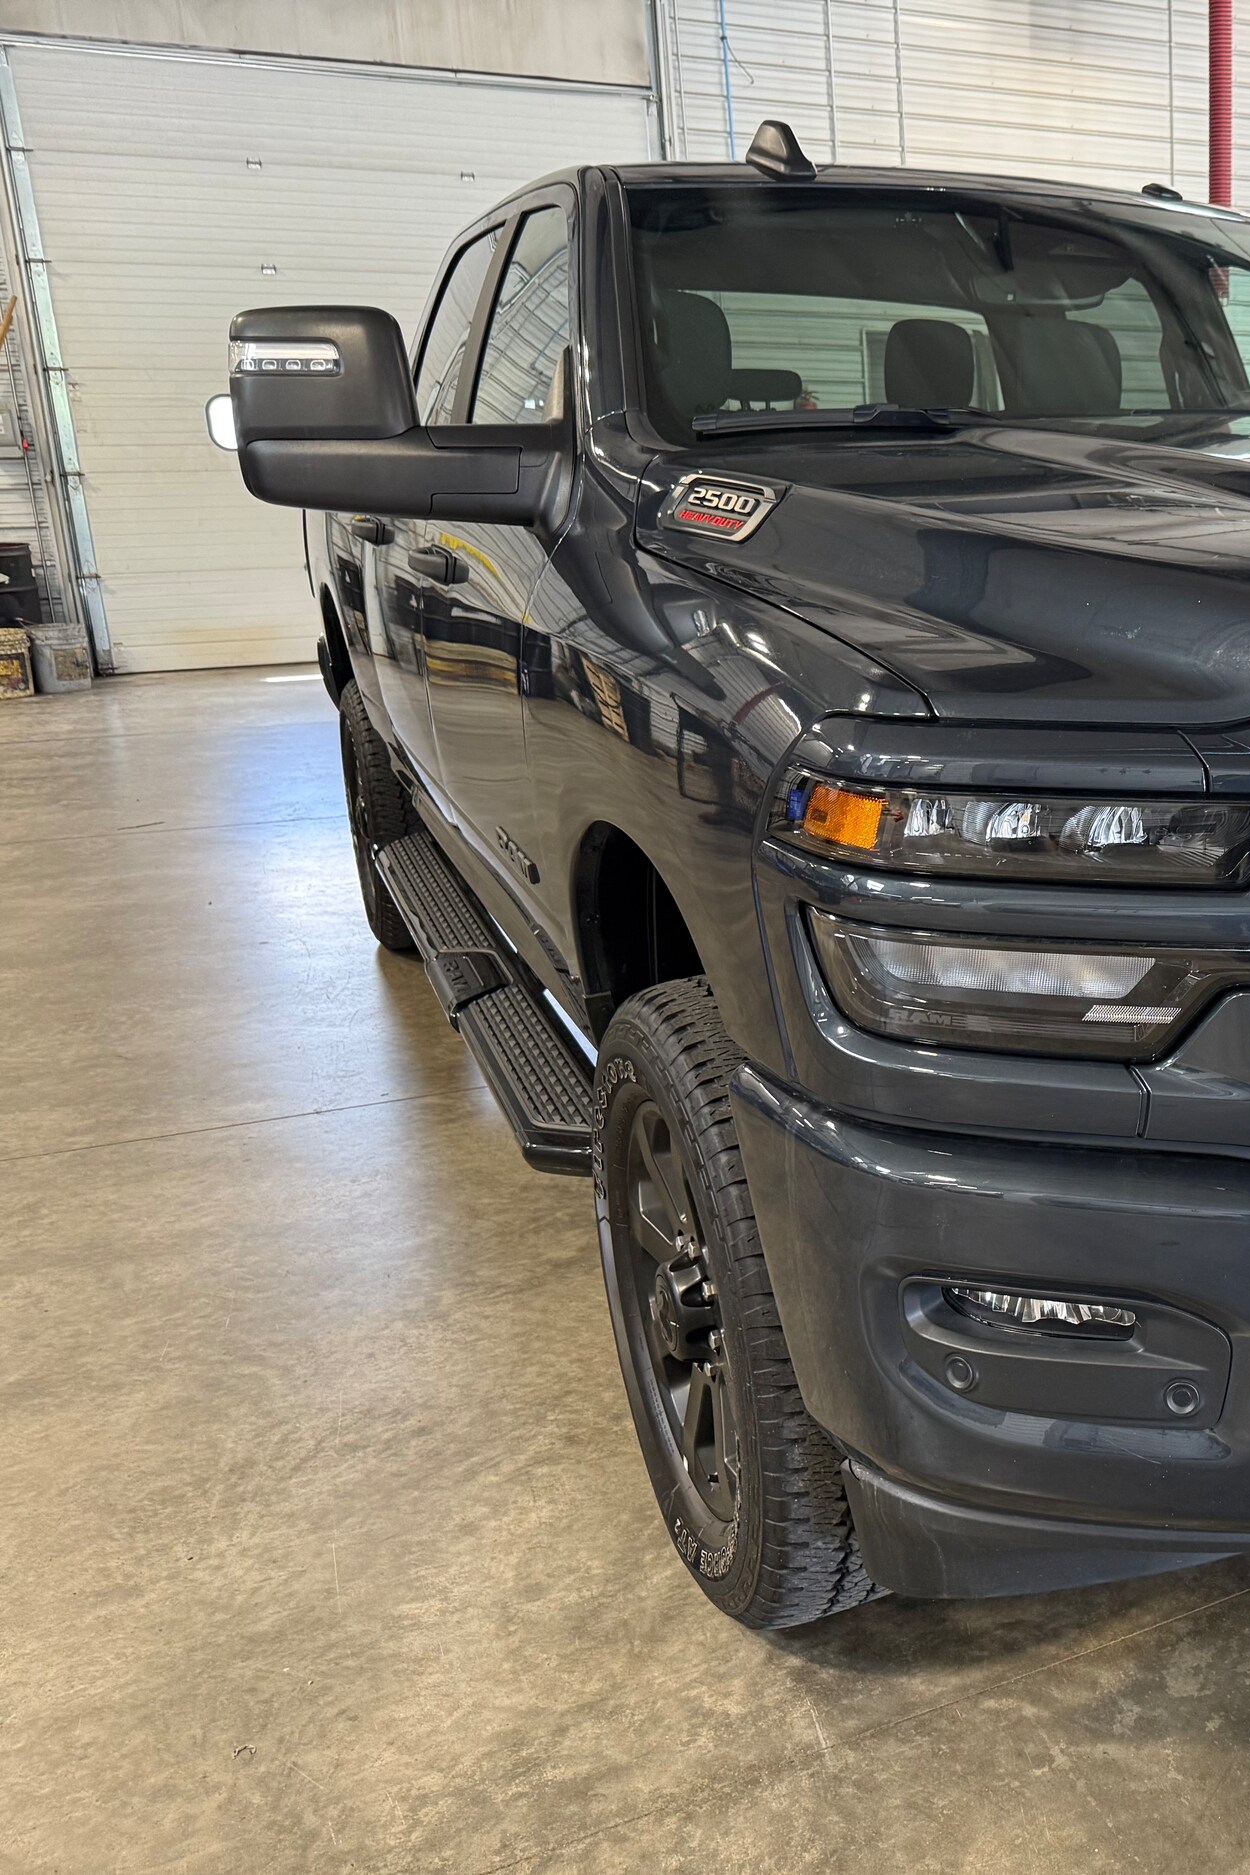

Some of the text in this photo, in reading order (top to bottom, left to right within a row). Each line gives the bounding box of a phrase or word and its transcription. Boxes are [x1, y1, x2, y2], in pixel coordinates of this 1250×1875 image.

[688, 488, 756, 513] 2500
[680, 510, 743, 529] HEAVY DUTY
[495, 826, 540, 884] RAM
[887, 1008, 953, 1027] RAM
